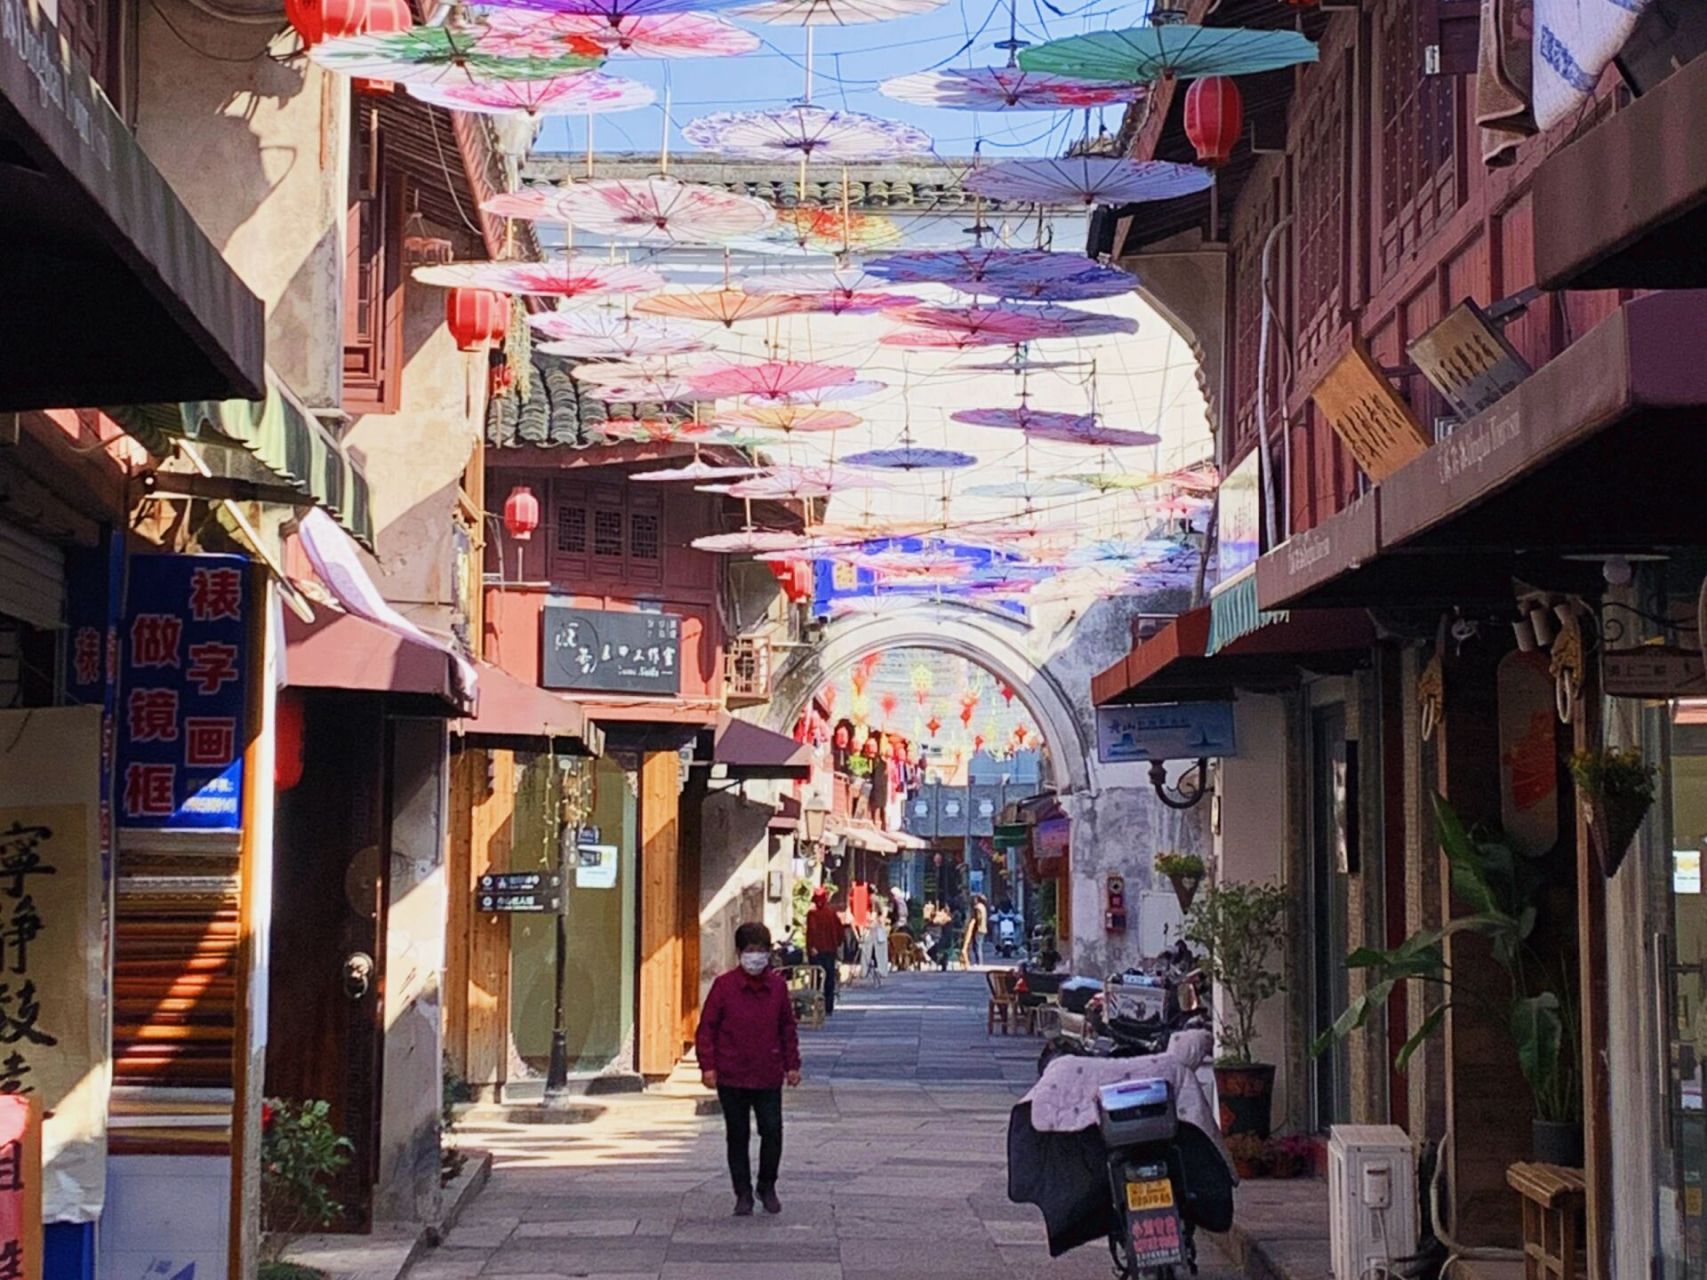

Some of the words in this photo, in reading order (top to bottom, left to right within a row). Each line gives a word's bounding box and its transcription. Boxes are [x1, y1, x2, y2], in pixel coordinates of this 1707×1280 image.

[126, 613, 182, 818] 做镜框
[186, 566, 242, 768] 裱字画
